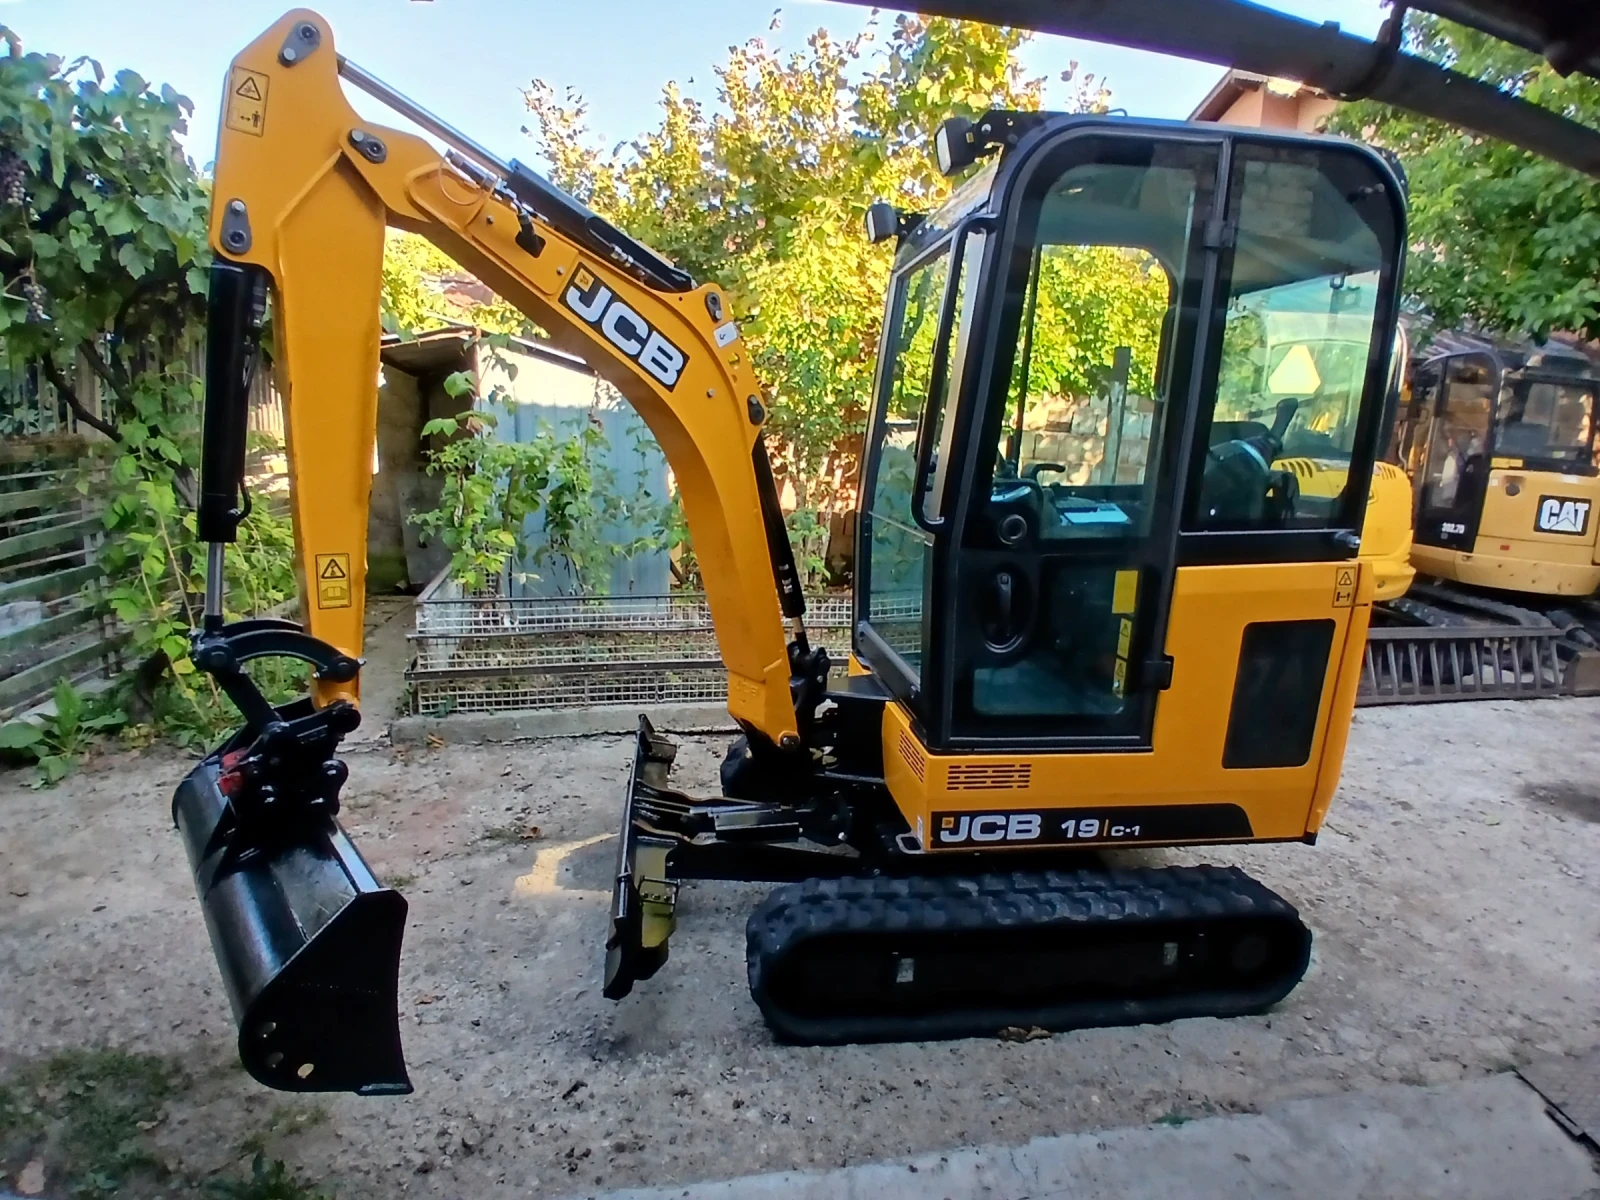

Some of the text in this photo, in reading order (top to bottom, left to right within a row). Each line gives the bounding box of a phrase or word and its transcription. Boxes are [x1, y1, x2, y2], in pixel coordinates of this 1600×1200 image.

[566, 286, 684, 385] JCB
[1540, 499, 1590, 533] CAT
[940, 814, 1042, 843] JCB
[1060, 819, 1100, 838] 19
